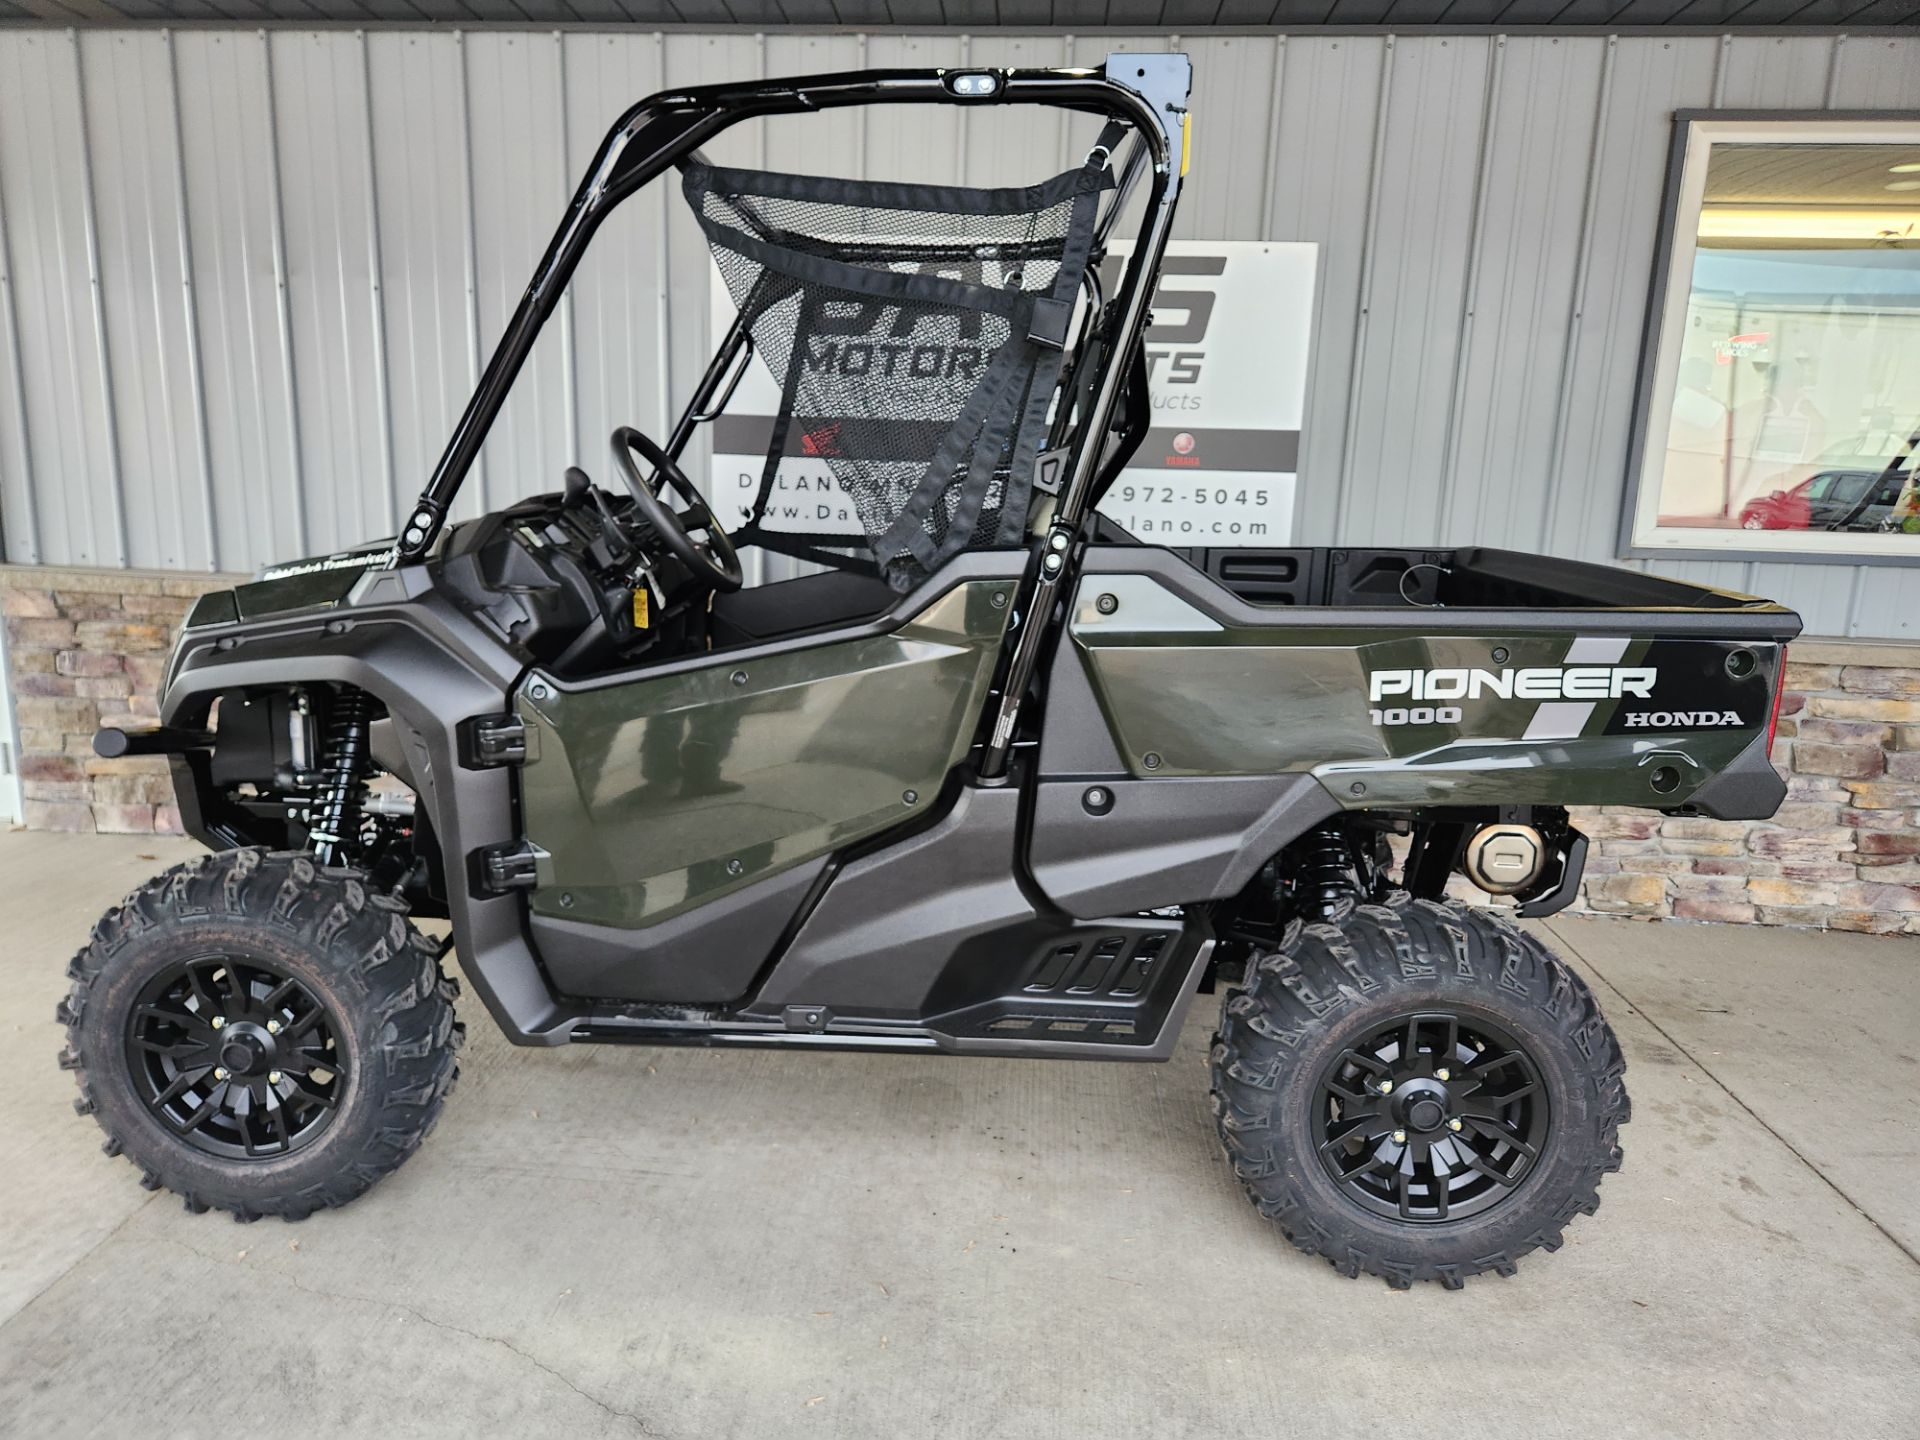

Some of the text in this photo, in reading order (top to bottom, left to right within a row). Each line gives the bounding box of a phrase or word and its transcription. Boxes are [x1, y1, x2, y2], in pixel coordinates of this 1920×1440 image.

[1109, 486, 1268, 506] -972-5045
[1369, 667, 1658, 702] PIONEER
[1369, 706, 1463, 726] 1000
[1624, 710, 1745, 727] HONDA
